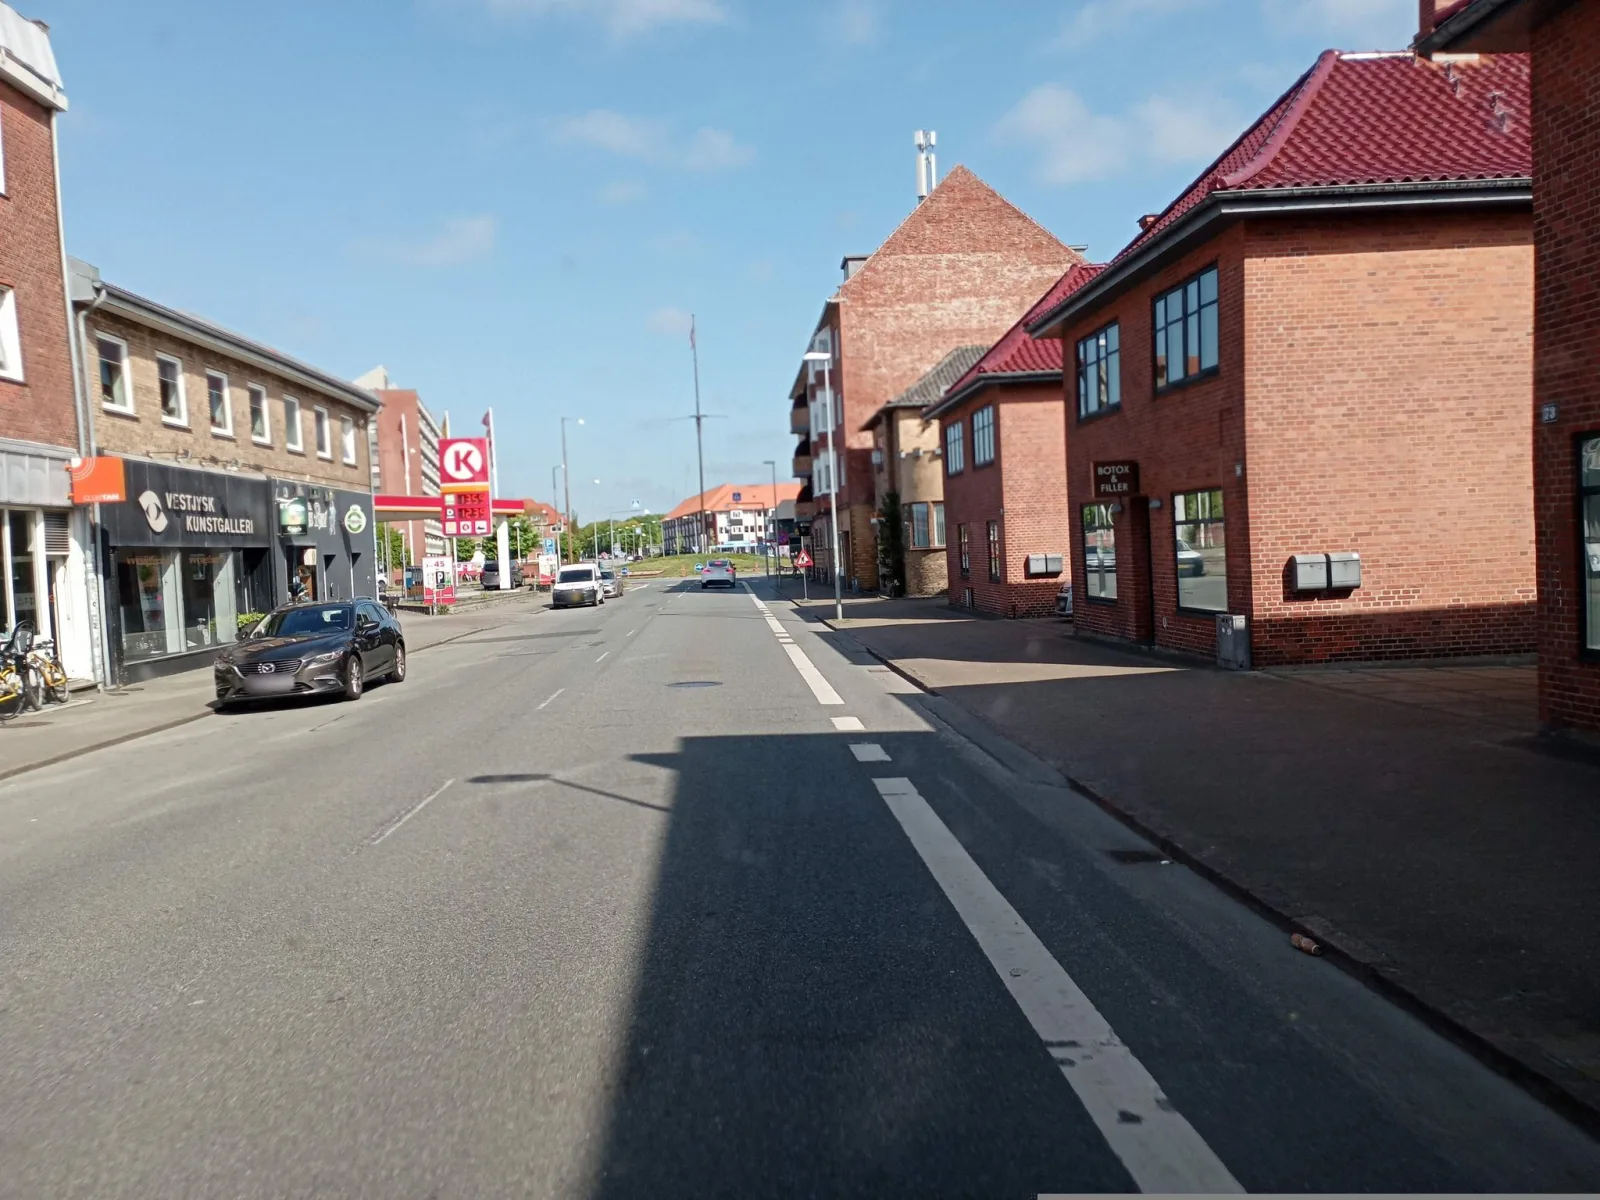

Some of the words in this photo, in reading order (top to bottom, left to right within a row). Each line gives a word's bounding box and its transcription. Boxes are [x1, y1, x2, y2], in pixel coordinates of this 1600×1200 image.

[1097, 465, 1130, 475] BOTOX
[1110, 474, 1118, 483] &
[1100, 483, 1129, 492] FILLER
[165, 492, 216, 512] VESTJYSK
[186, 515, 254, 534] KUNSTGALLERI
